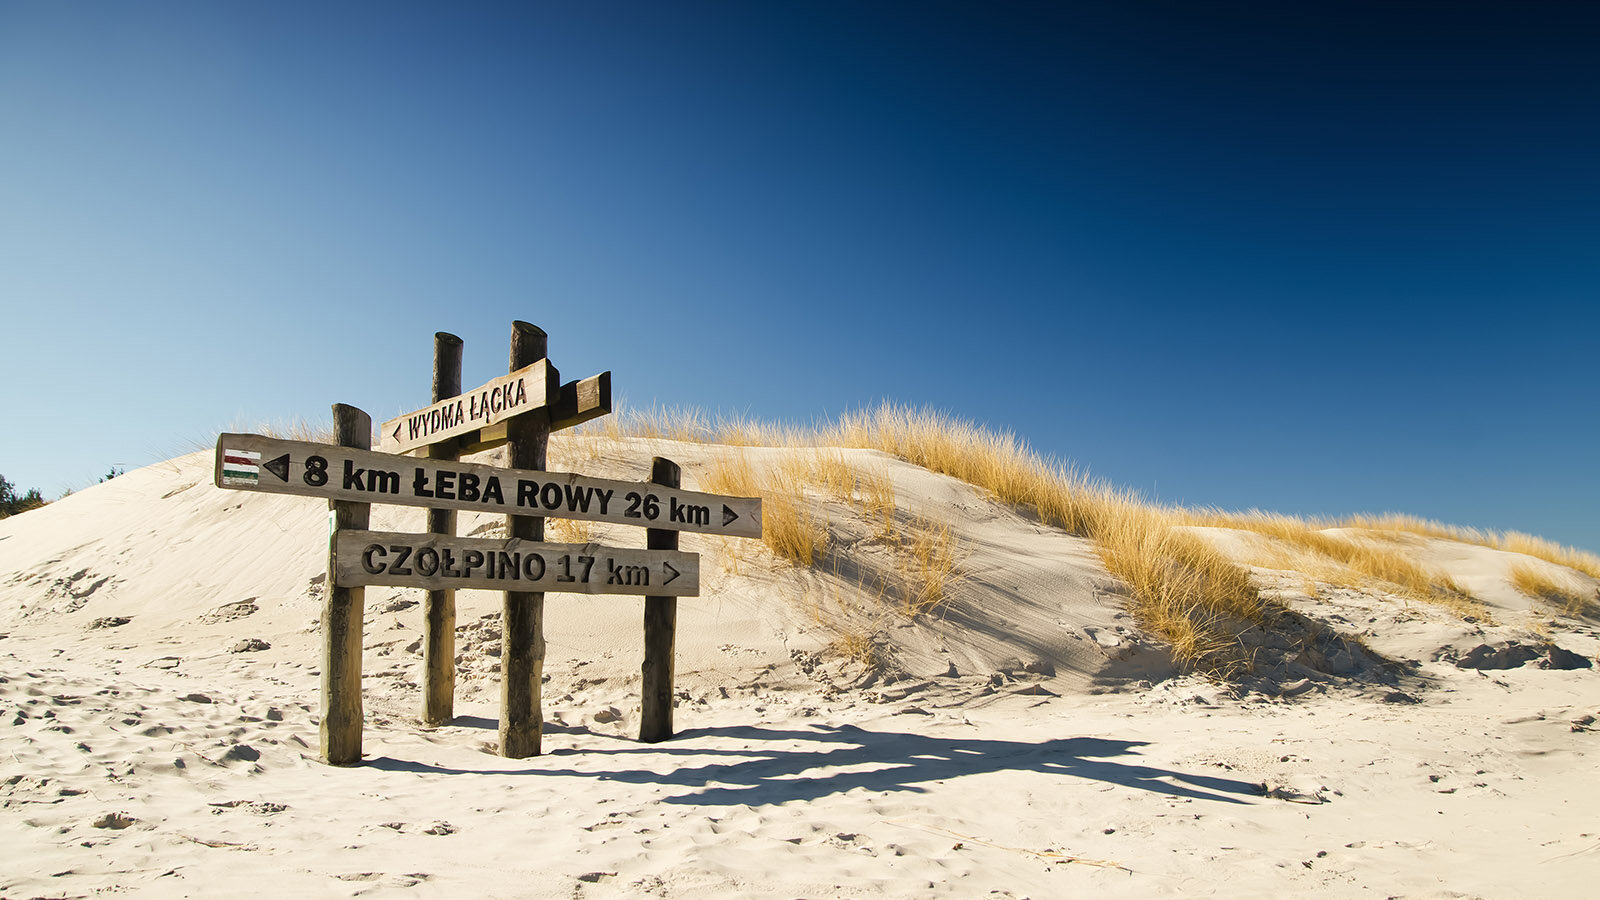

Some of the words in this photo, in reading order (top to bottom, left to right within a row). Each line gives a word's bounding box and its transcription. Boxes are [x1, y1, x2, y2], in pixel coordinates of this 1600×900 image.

[408, 399, 464, 441] WYDMA
[469, 377, 528, 424] ŁĄCKA
[303, 455, 329, 487] 8
[342, 459, 401, 494] km
[412, 467, 504, 504] ŁEBA
[516, 479, 614, 515] ROWY
[624, 492, 660, 521] 26
[669, 497, 710, 526] km
[361, 543, 546, 582] CZOŁPINO
[556, 554, 596, 583] 17
[606, 558, 650, 586] km
